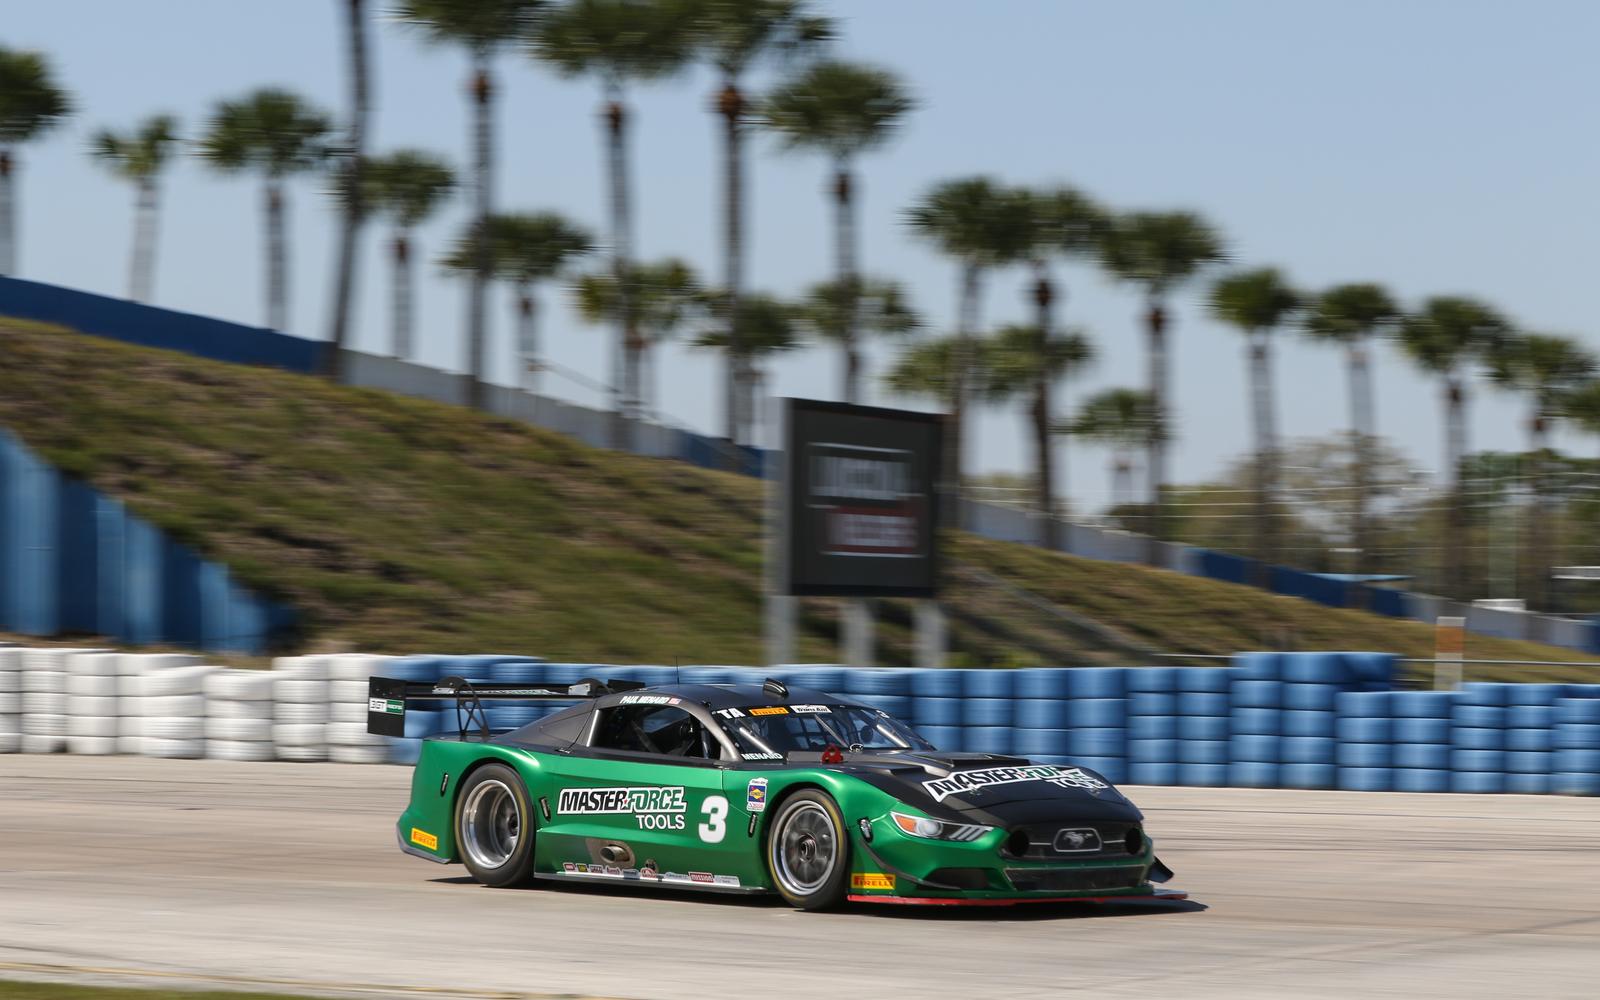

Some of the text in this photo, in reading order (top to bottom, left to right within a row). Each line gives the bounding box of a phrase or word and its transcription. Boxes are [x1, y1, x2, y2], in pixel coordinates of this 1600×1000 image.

[620, 695, 670, 704] PAUL MENARD
[717, 707, 746, 719] TA
[741, 752, 783, 761] MENARD
[925, 765, 1092, 800] MASTERFO
[559, 789, 685, 812] MASTERFORCE
[635, 814, 685, 829] TOOLS
[698, 795, 728, 844] 3
[853, 875, 895, 887] PIRELLI
